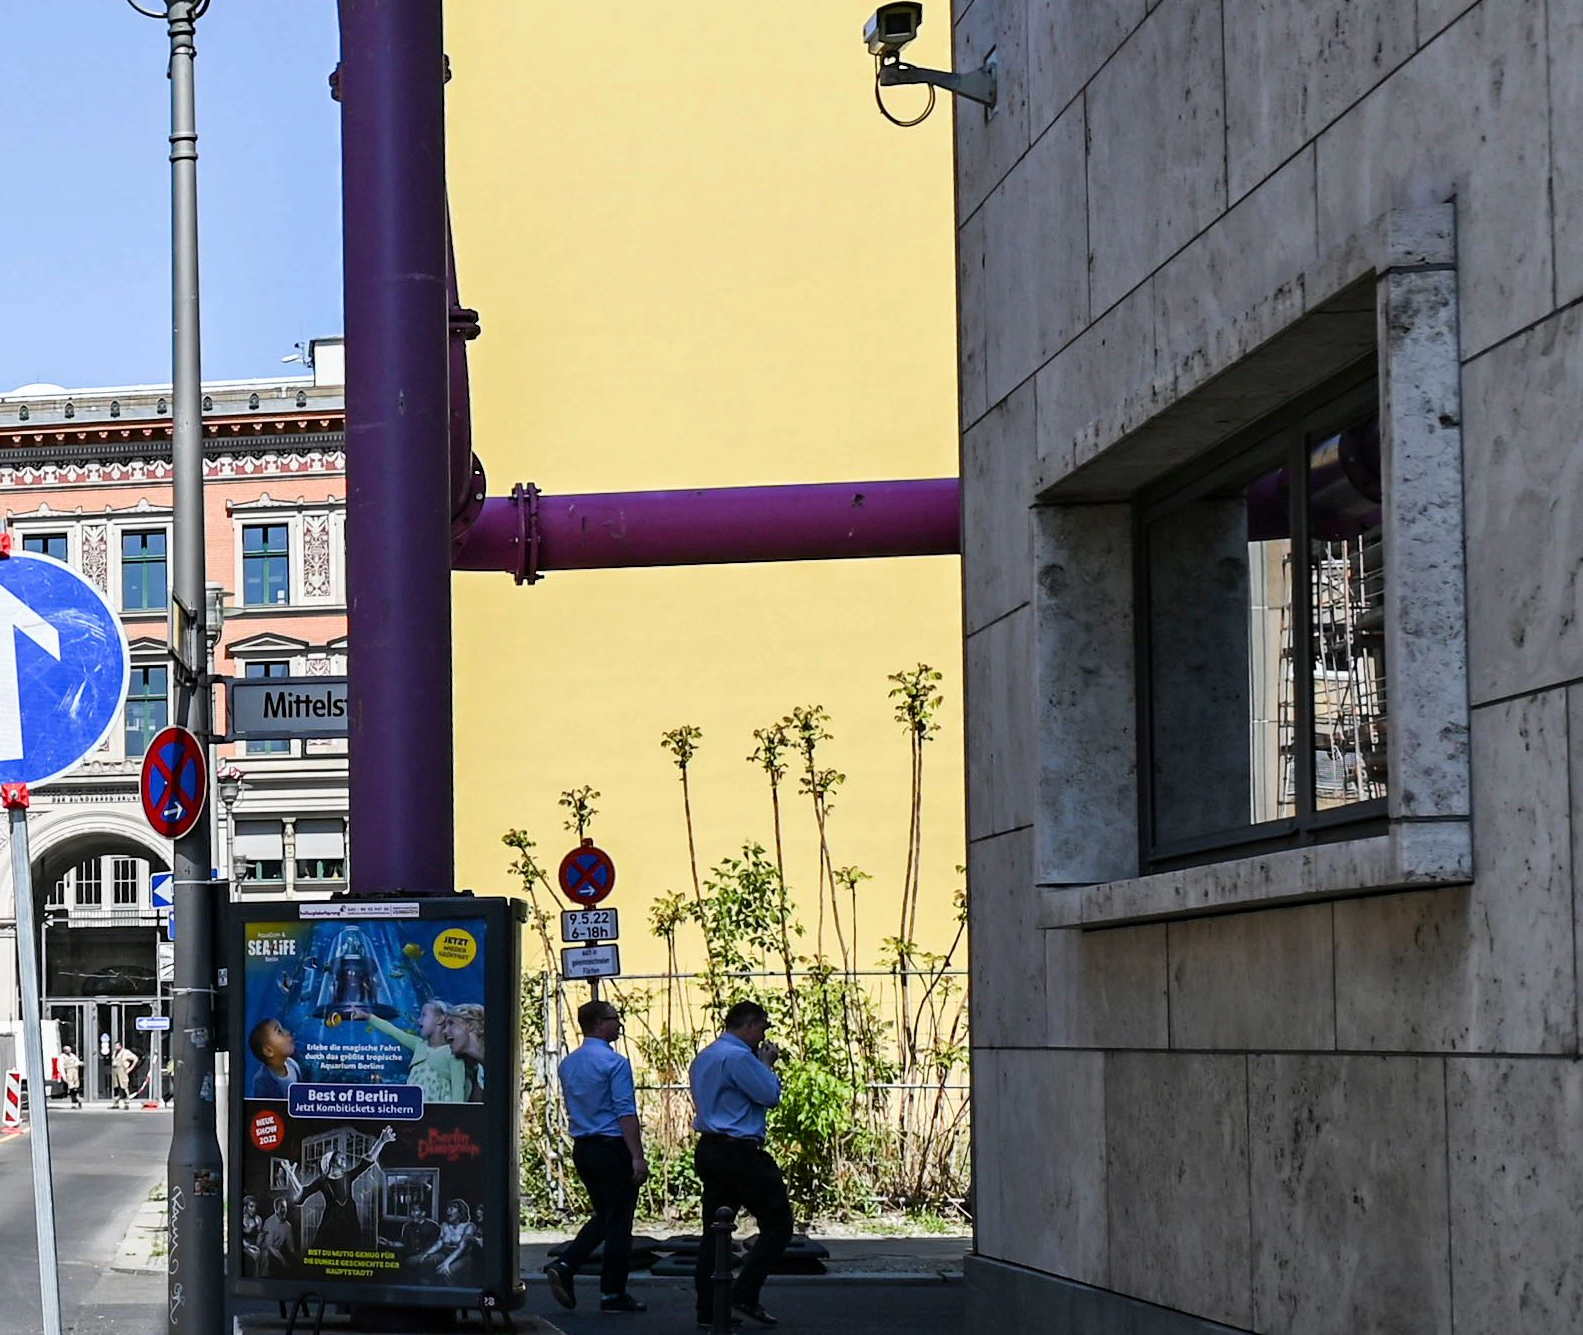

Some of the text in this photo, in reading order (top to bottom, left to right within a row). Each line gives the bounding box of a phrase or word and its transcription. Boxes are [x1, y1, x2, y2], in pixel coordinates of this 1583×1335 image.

[569, 912, 609, 925] 9.5.22
[572, 926, 608, 939] 6-18h
[444, 936, 469, 947] JETZT
[248, 940, 270, 956] SEA
[342, 1044, 377, 1053] magische
[379, 1044, 401, 1052] Fahrt
[340, 1054, 365, 1062] größte
[366, 1054, 403, 1062] tropische
[321, 1063, 356, 1071] Aquarium
[308, 1089, 398, 1103] Best of Berlin
[295, 1103, 414, 1114] Jetzt Kombitickets sichern
[256, 1116, 275, 1126] NEUE
[256, 1126, 278, 1136] SHOW
[259, 1135, 277, 1145] 2022
[355, 1250, 380, 1258] GENUG
[381, 1249, 395, 1259] FÜR
[314, 1258, 339, 1266] DUNKLE
[340, 1259, 384, 1268] GESCHICHTE
[385, 1260, 400, 1268] DER
